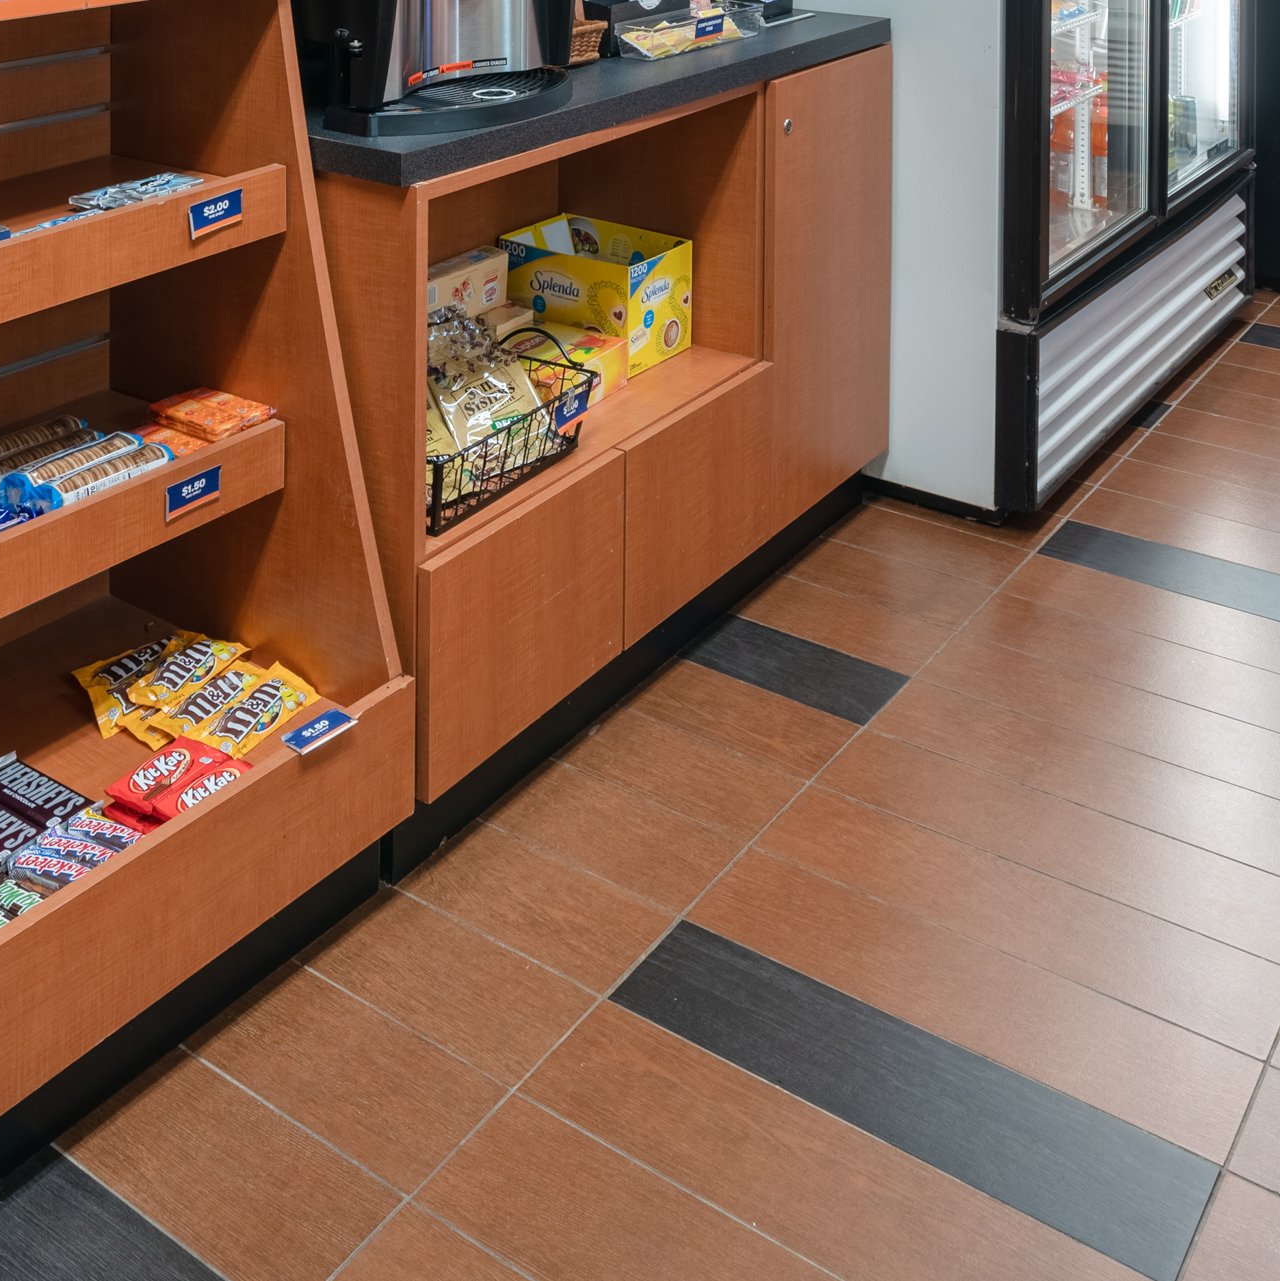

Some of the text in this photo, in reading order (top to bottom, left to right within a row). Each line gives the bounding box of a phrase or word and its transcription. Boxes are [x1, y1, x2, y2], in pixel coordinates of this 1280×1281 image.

[203, 199, 229, 217] $2.00
[501, 240, 526, 257] 1200
[630, 264, 648, 278] 1200
[530, 270, 580, 298] Splenda
[641, 279, 670, 304] Splenda
[181, 478, 207, 497] $1.50
[302, 719, 330, 739] $1.50
[131, 750, 186, 791] Kit Kat
[181, 769, 238, 810] Kit Kat
